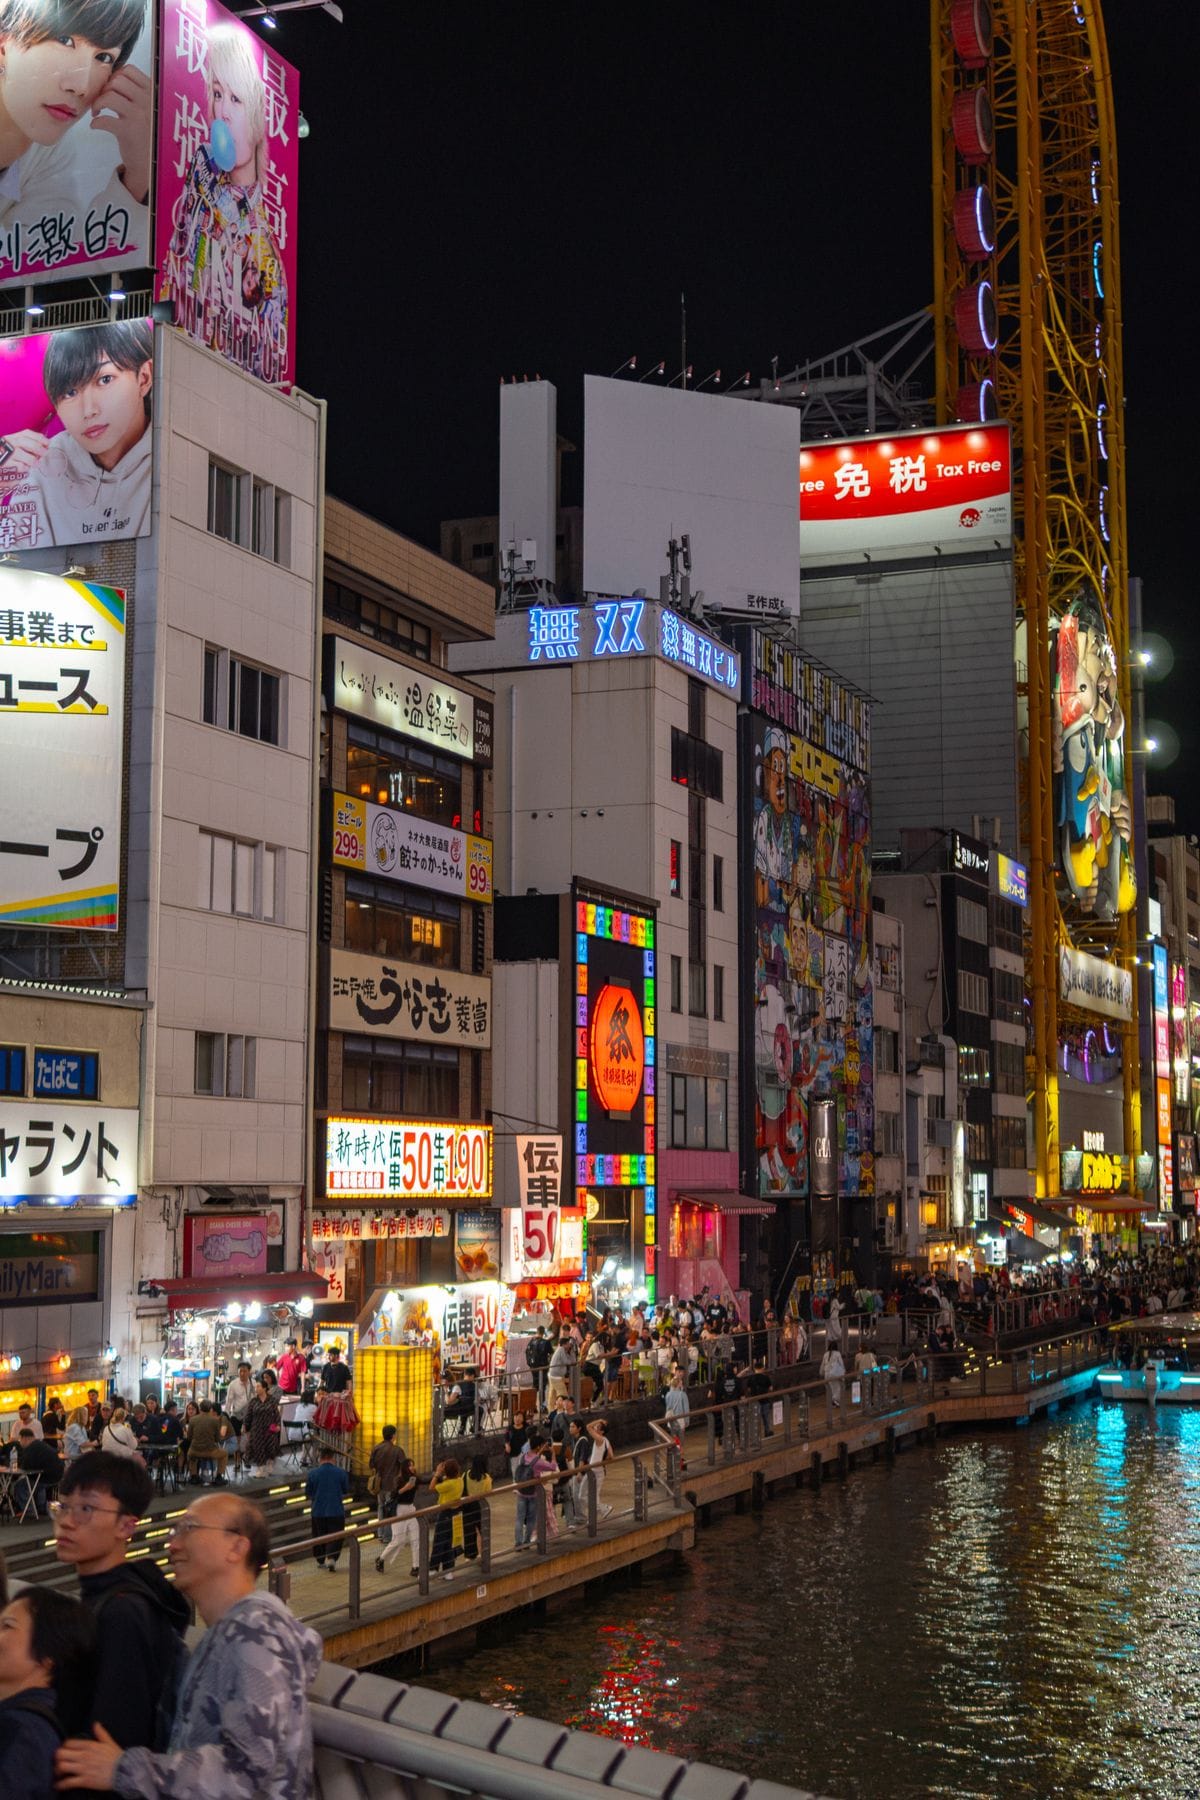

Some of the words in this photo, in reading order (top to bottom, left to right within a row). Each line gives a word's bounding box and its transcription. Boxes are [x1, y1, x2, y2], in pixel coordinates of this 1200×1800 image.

[800, 480, 825, 493] ree
[834, 455, 927, 500] 免税
[936, 463, 964, 478] Tax
[968, 460, 1002, 474] Free
[0, 609, 96, 645] 事業まで
[530, 602, 645, 660] 無双
[683, 624, 737, 688] 無双ビル
[790, 734, 841, 797] 2025
[338, 810, 362, 828] 生ビール
[408, 829, 449, 853] ネオ大衆居酒屋
[400, 844, 463, 880] 餃子のかっちゃん
[333, 977, 378, 1000] 江戸焼
[356, 966, 452, 1034] うなぎ
[454, 996, 488, 1034] 菱富
[606, 995, 637, 1065] 祭
[37, 1058, 79, 1091] たばこ
[335, 1128, 386, 1166] 新時代
[389, 1131, 401, 1190] 伝串
[402, 1132, 432, 1190] 50
[433, 1132, 445, 1190] 生中
[446, 1134, 484, 1190] 190
[523, 1141, 559, 1208] 伝串
